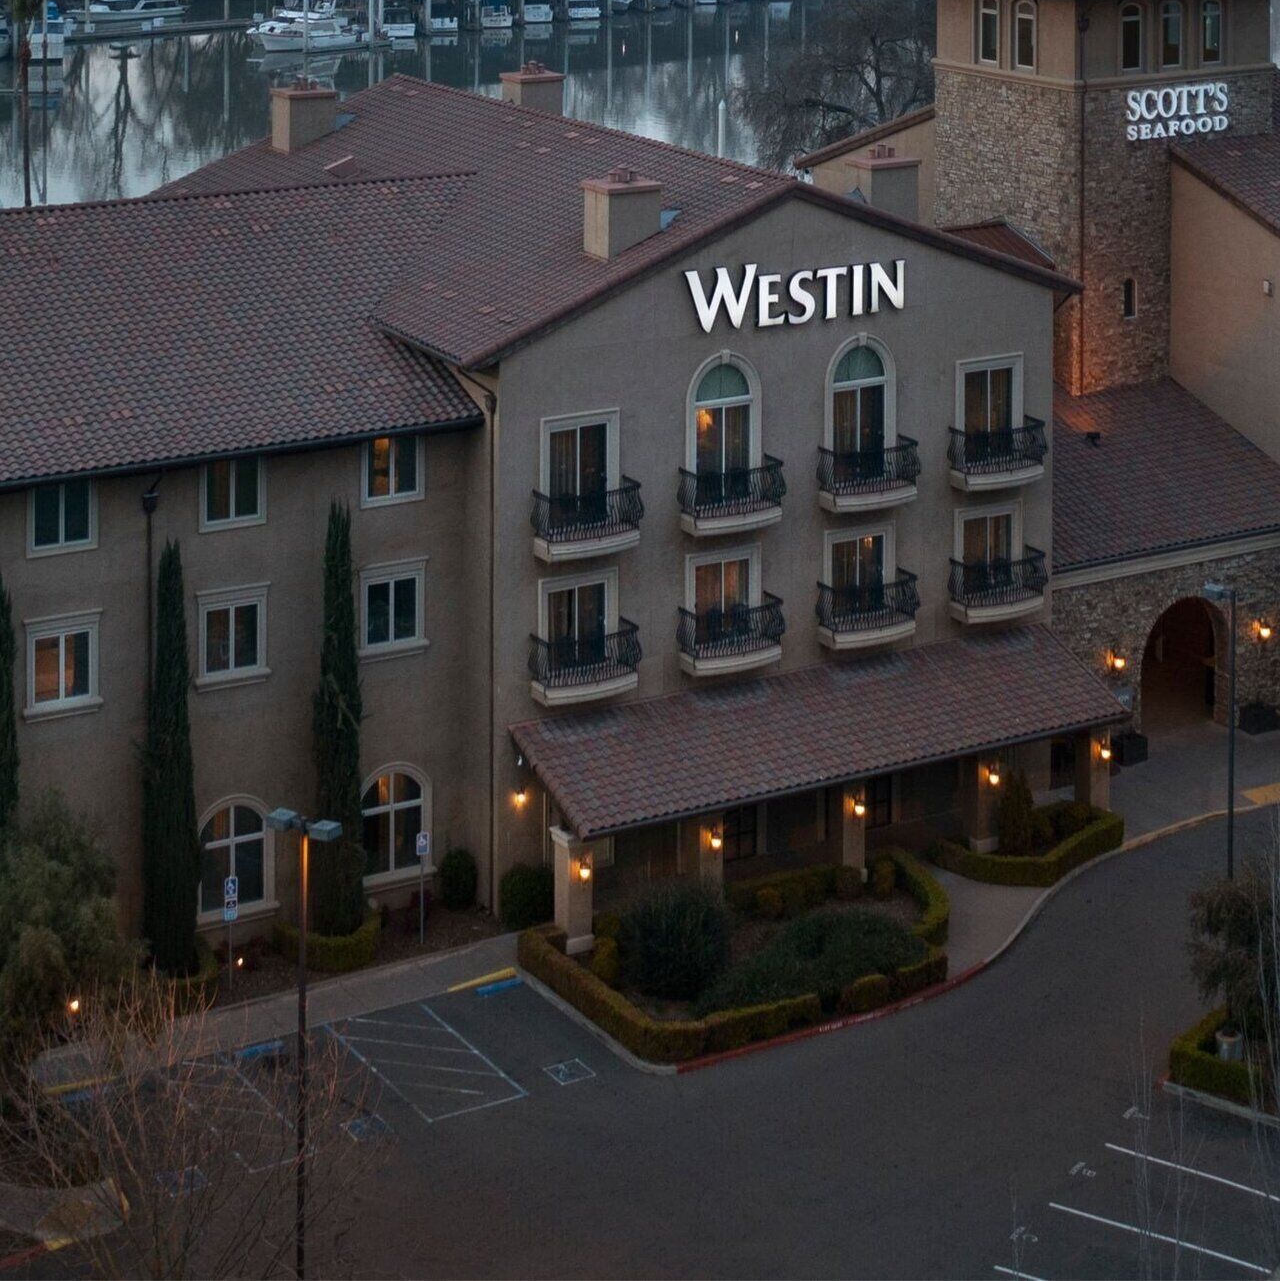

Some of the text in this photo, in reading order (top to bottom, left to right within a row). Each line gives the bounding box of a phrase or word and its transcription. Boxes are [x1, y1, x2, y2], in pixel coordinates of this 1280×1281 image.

[1126, 82, 1229, 122] SCOTT'S
[1126, 115, 1229, 141] SEAFOOD
[684, 259, 906, 334] WESTIN
